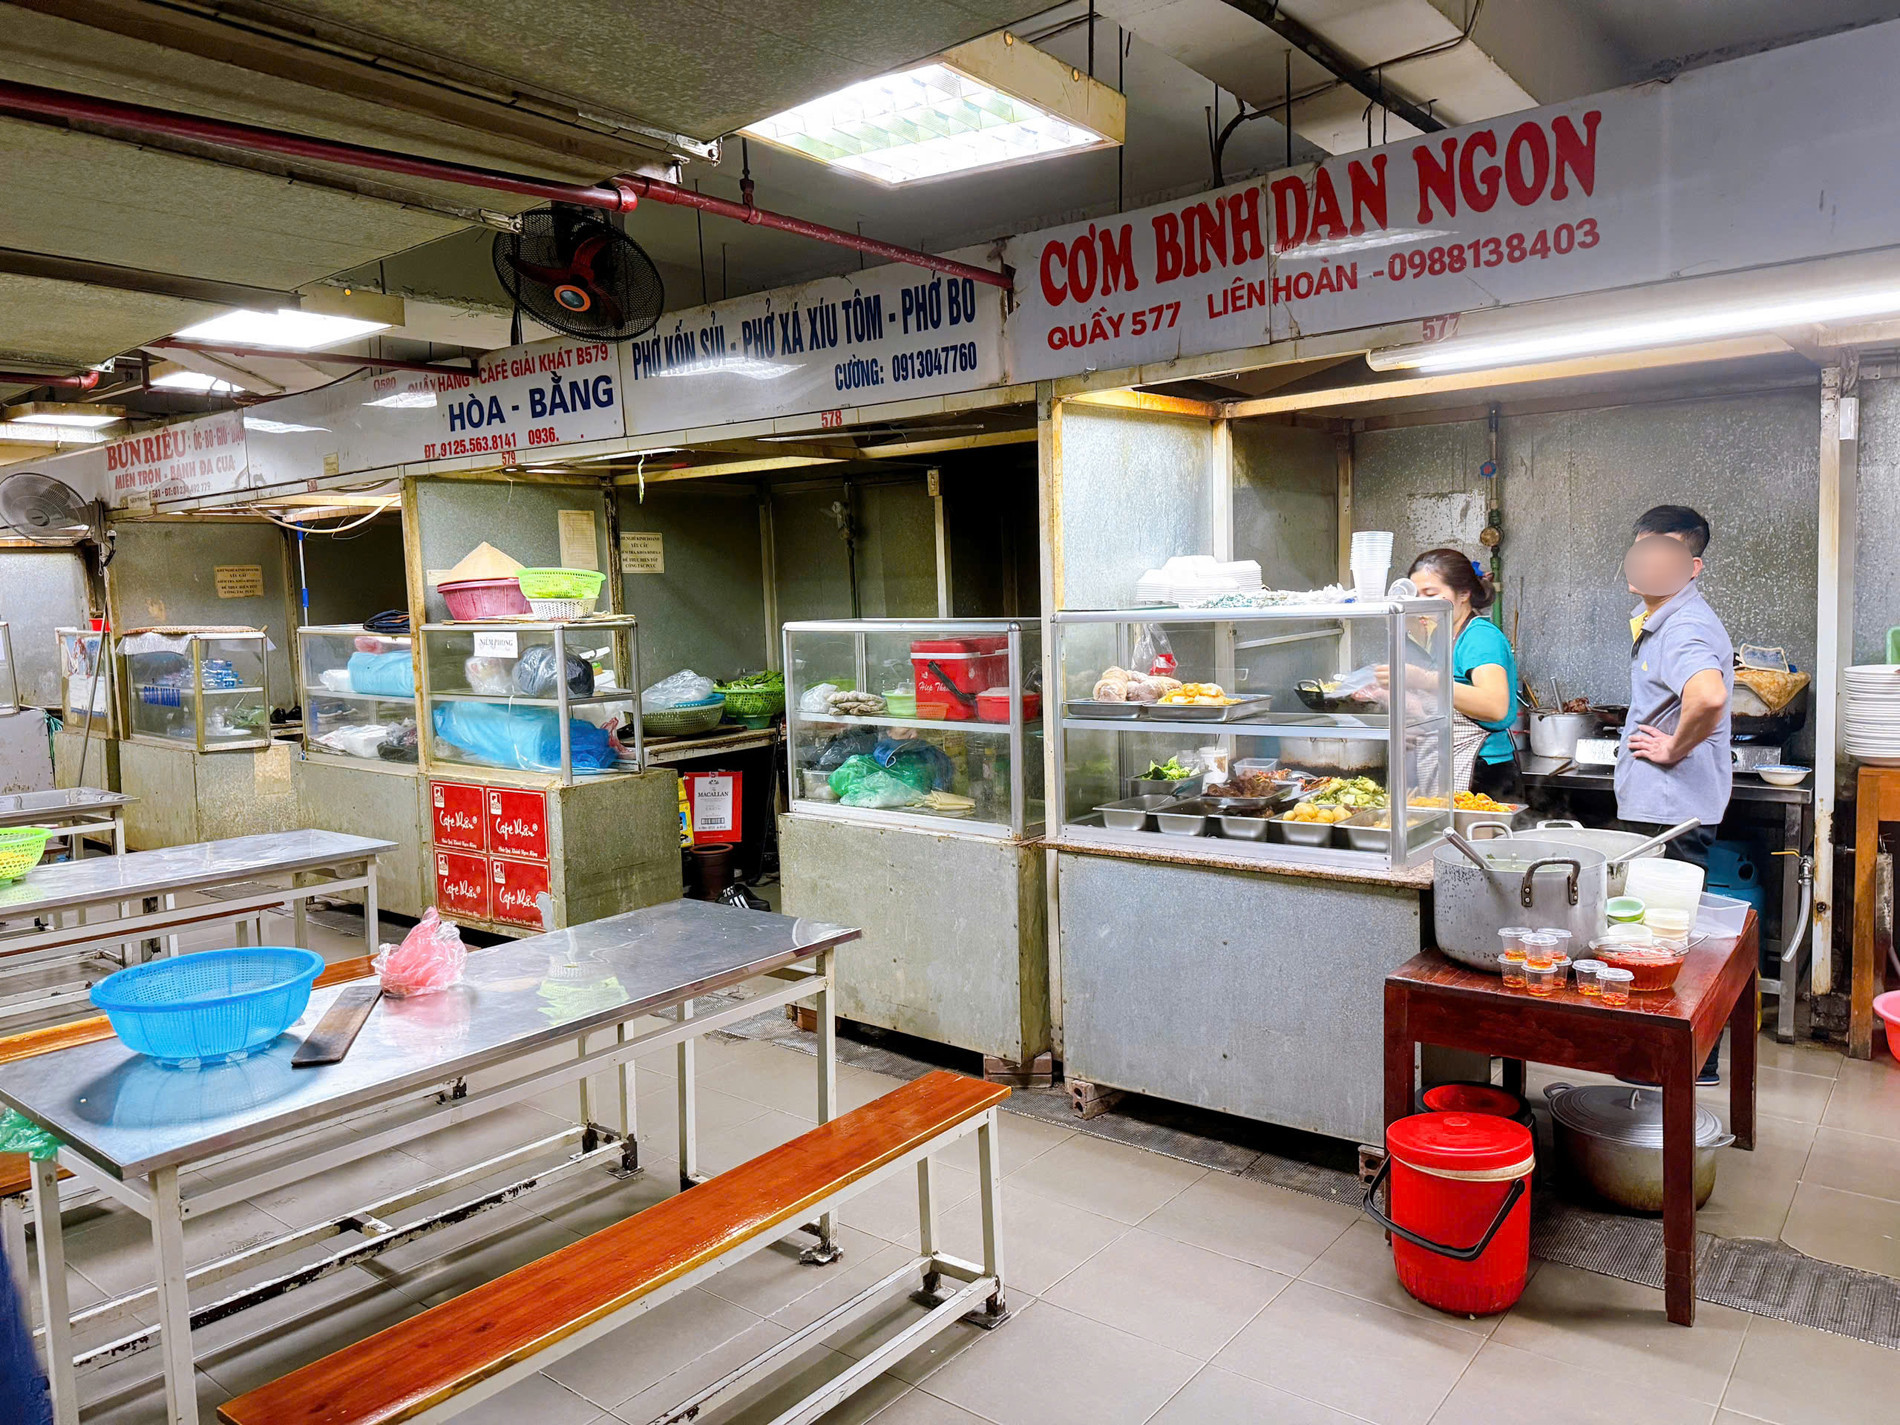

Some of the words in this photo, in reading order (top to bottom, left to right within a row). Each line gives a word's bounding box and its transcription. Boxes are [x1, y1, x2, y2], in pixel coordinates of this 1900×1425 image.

[1040, 223, 1139, 307] CƠM
[1412, 110, 1602, 225] NGON
[742, 297, 776, 363] PHỞ
[778, 301, 805, 356] XÁ
[807, 296, 838, 351] XÍU
[841, 288, 884, 344] TÔM
[1047, 307, 1126, 350] QUẦY
[1131, 301, 1182, 336] 577
[1207, 276, 1266, 319] LIÊN
[511, 349, 536, 377] GIẢI
[538, 346, 573, 372] KHÁT
[576, 342, 608, 366] B579
[891, 341, 978, 382] 0913047760
[448, 393, 506, 432] HÒA
[529, 370, 615, 419] BẰNG
[821, 410, 843, 428] 578
[107, 436, 142, 471] BÚN
[502, 451, 517, 466] 579
